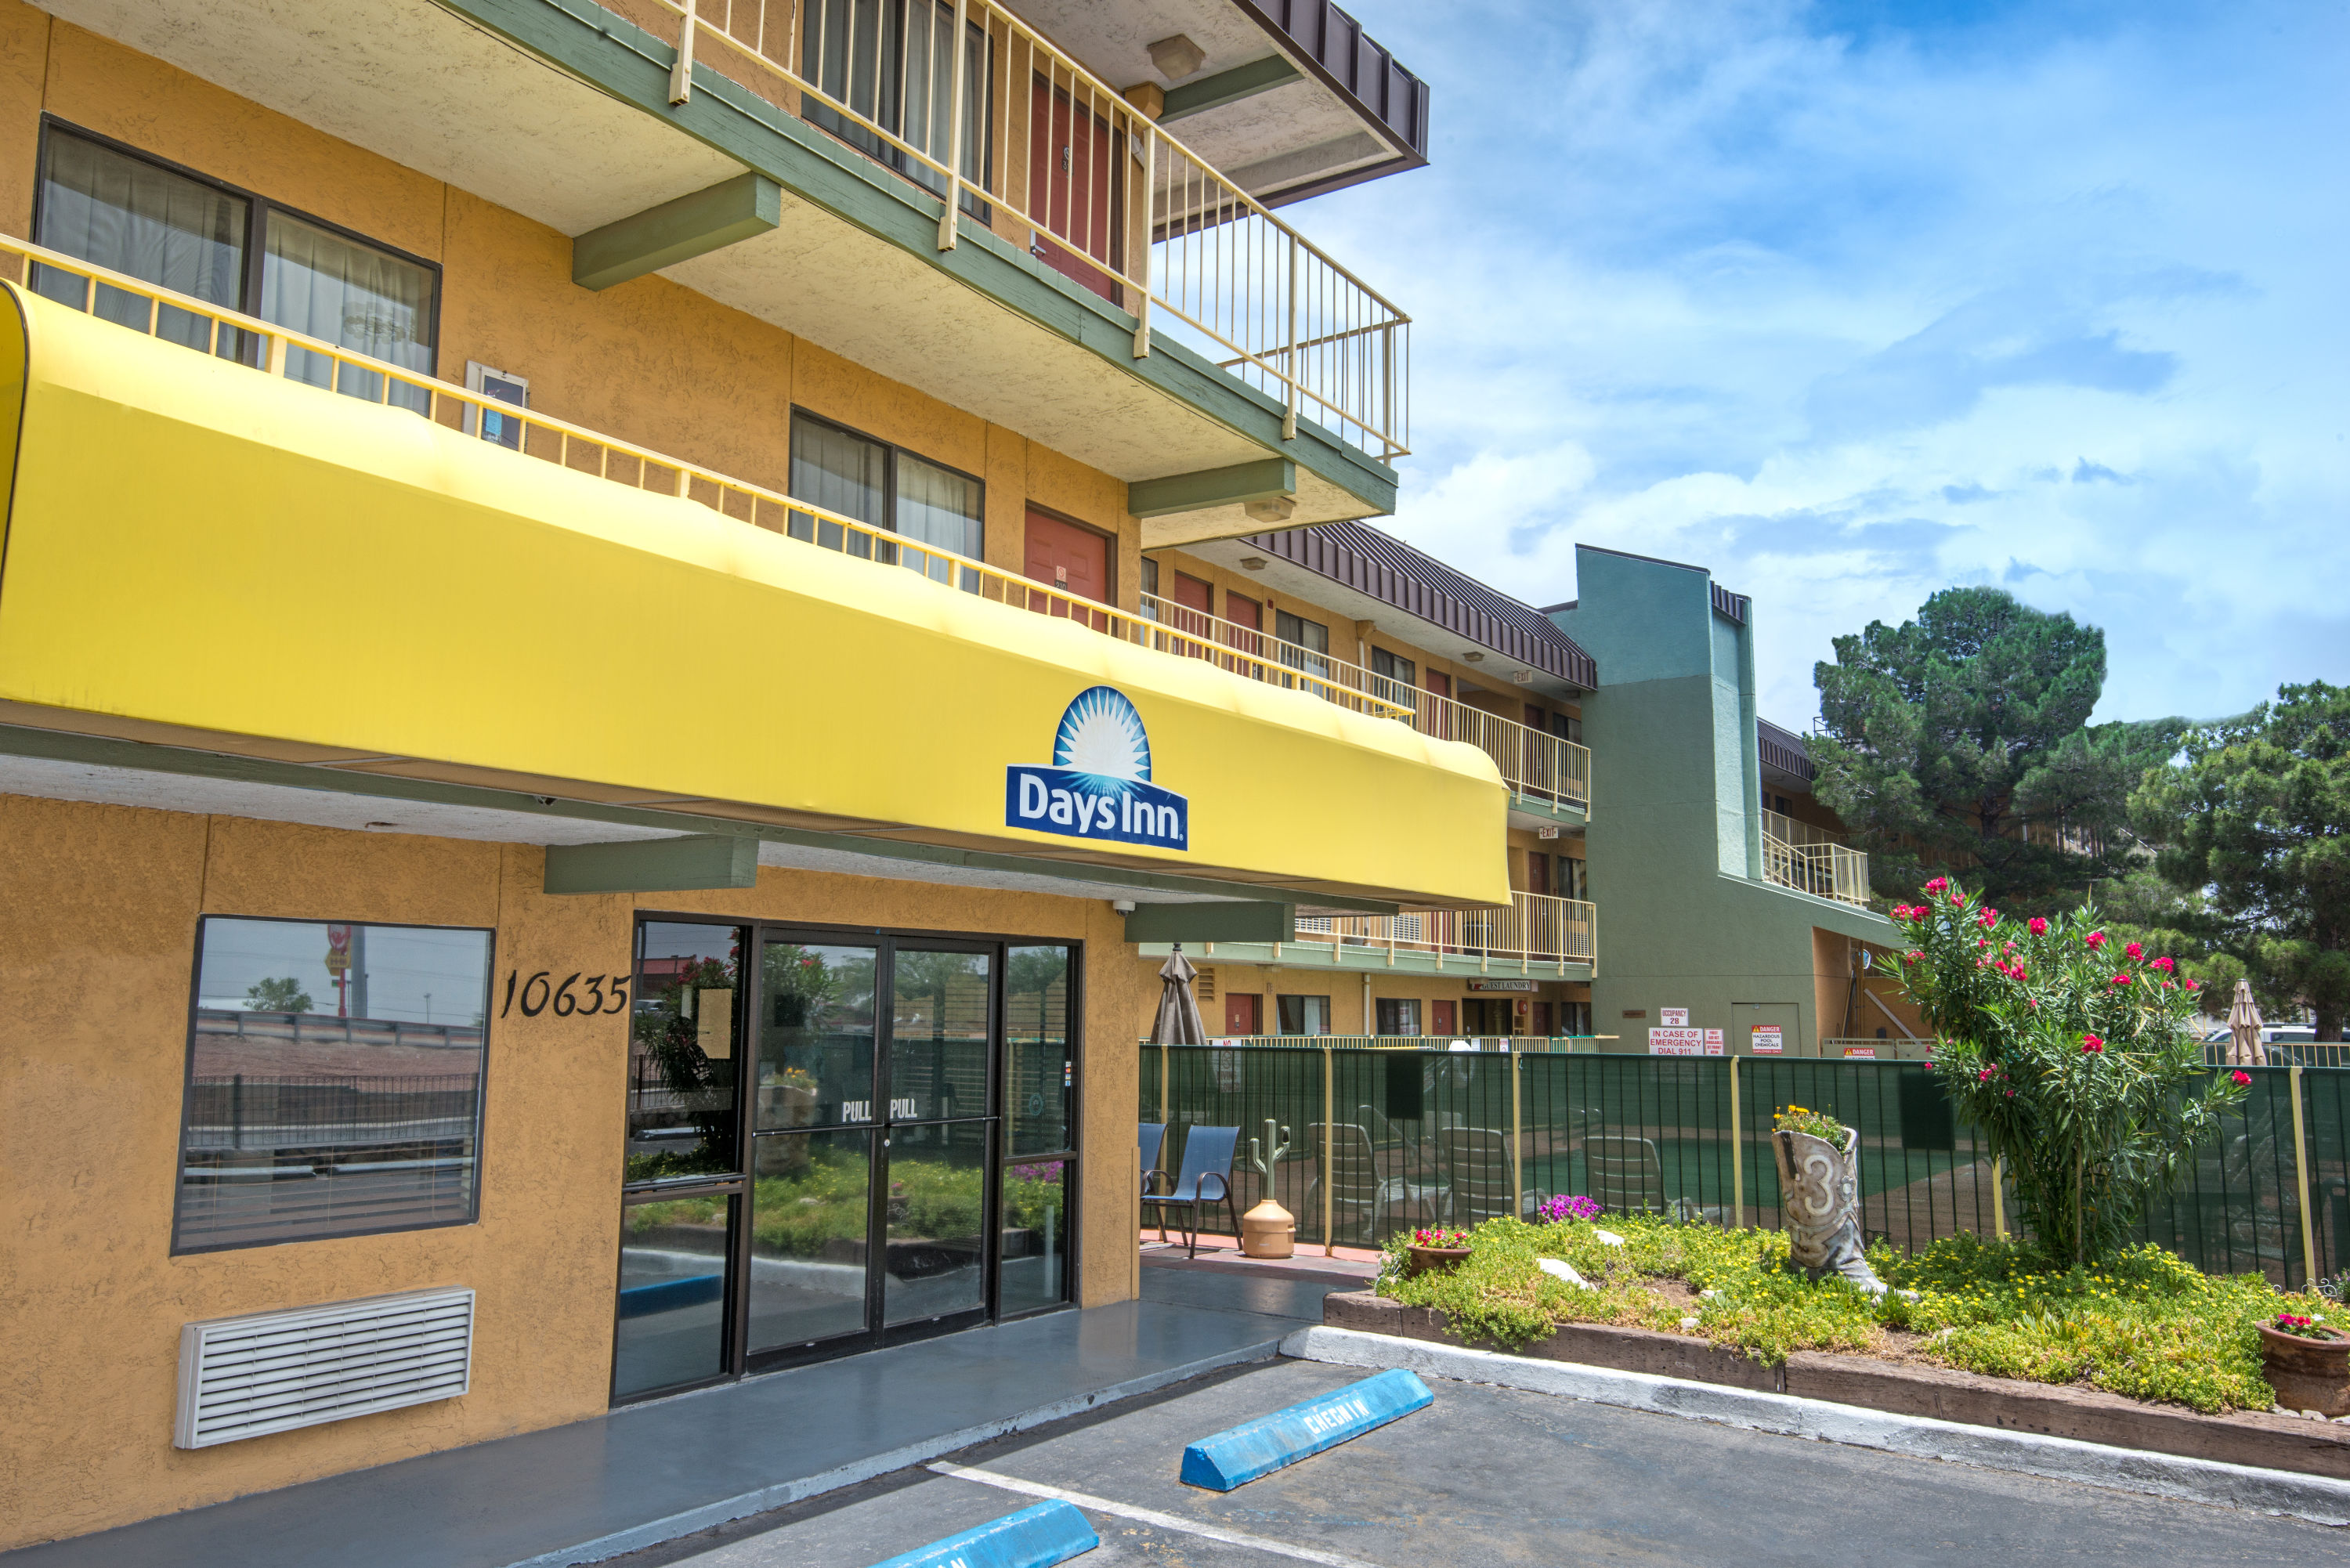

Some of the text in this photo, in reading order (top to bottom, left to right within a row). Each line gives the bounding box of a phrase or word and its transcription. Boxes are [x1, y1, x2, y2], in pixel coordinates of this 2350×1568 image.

[1517, 671, 1529, 681] EXIT
[1019, 772, 1179, 840] Days Inn
[1542, 828, 1554, 837] EXIT
[501, 969, 632, 1018] 10635
[842, 1098, 917, 1122] PULL PULL
